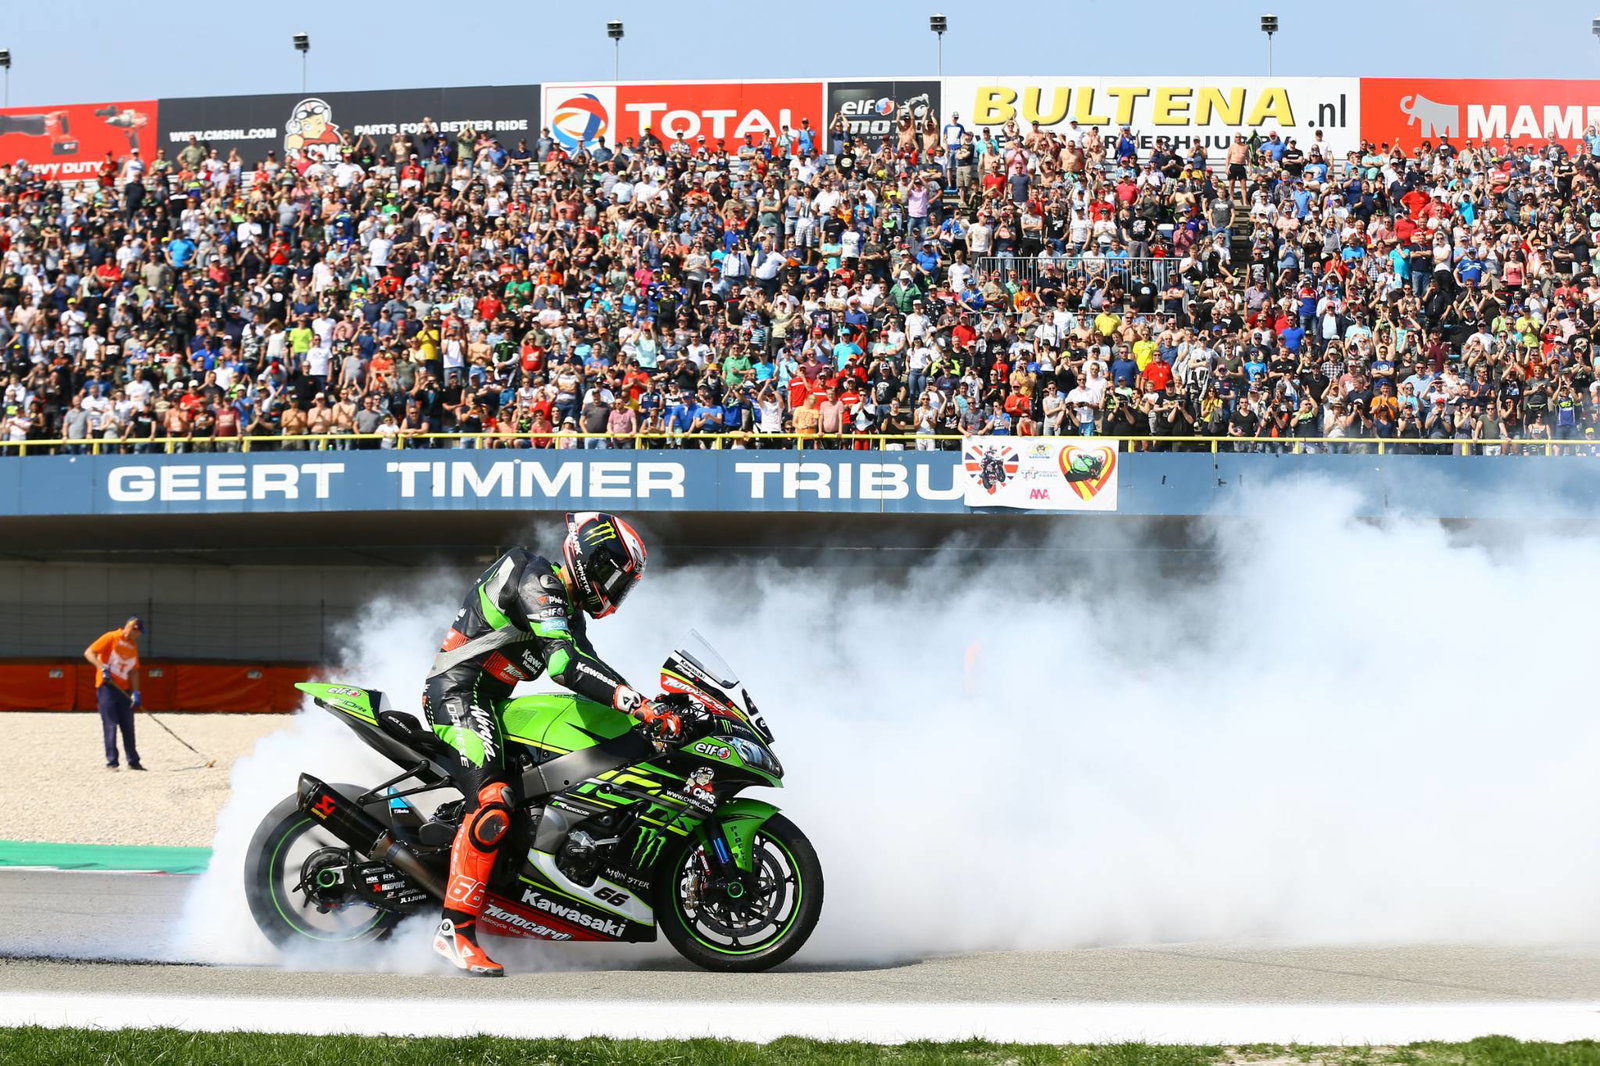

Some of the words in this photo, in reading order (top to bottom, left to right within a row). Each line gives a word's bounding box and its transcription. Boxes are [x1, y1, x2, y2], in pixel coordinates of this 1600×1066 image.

[841, 100, 875, 114] elf
[973, 86, 1296, 126] BULTENA
[1308, 93, 1346, 128] .nl
[354, 125, 397, 135] PARTS
[440, 120, 493, 132] BETTER
[495, 120, 528, 130] RIDE
[625, 102, 800, 141] TOTAL
[169, 128, 277, 142] WWW.CMSNL.COM
[11, 162, 60, 175] HAVY
[62, 160, 103, 173] DUTY
[107, 463, 345, 501] GEERT
[387, 461, 685, 498] TIMMER
[735, 463, 965, 500] TRIBU
[540, 608, 557, 617] elf
[576, 662, 618, 688] Kawasak
[469, 705, 500, 762] Ninja
[695, 743, 719, 756] elf
[693, 787, 716, 805] CMS
[448, 875, 486, 908] 66
[594, 886, 630, 907] 66
[484, 904, 572, 941] Motocard
[521, 888, 626, 938] Kawasaki
